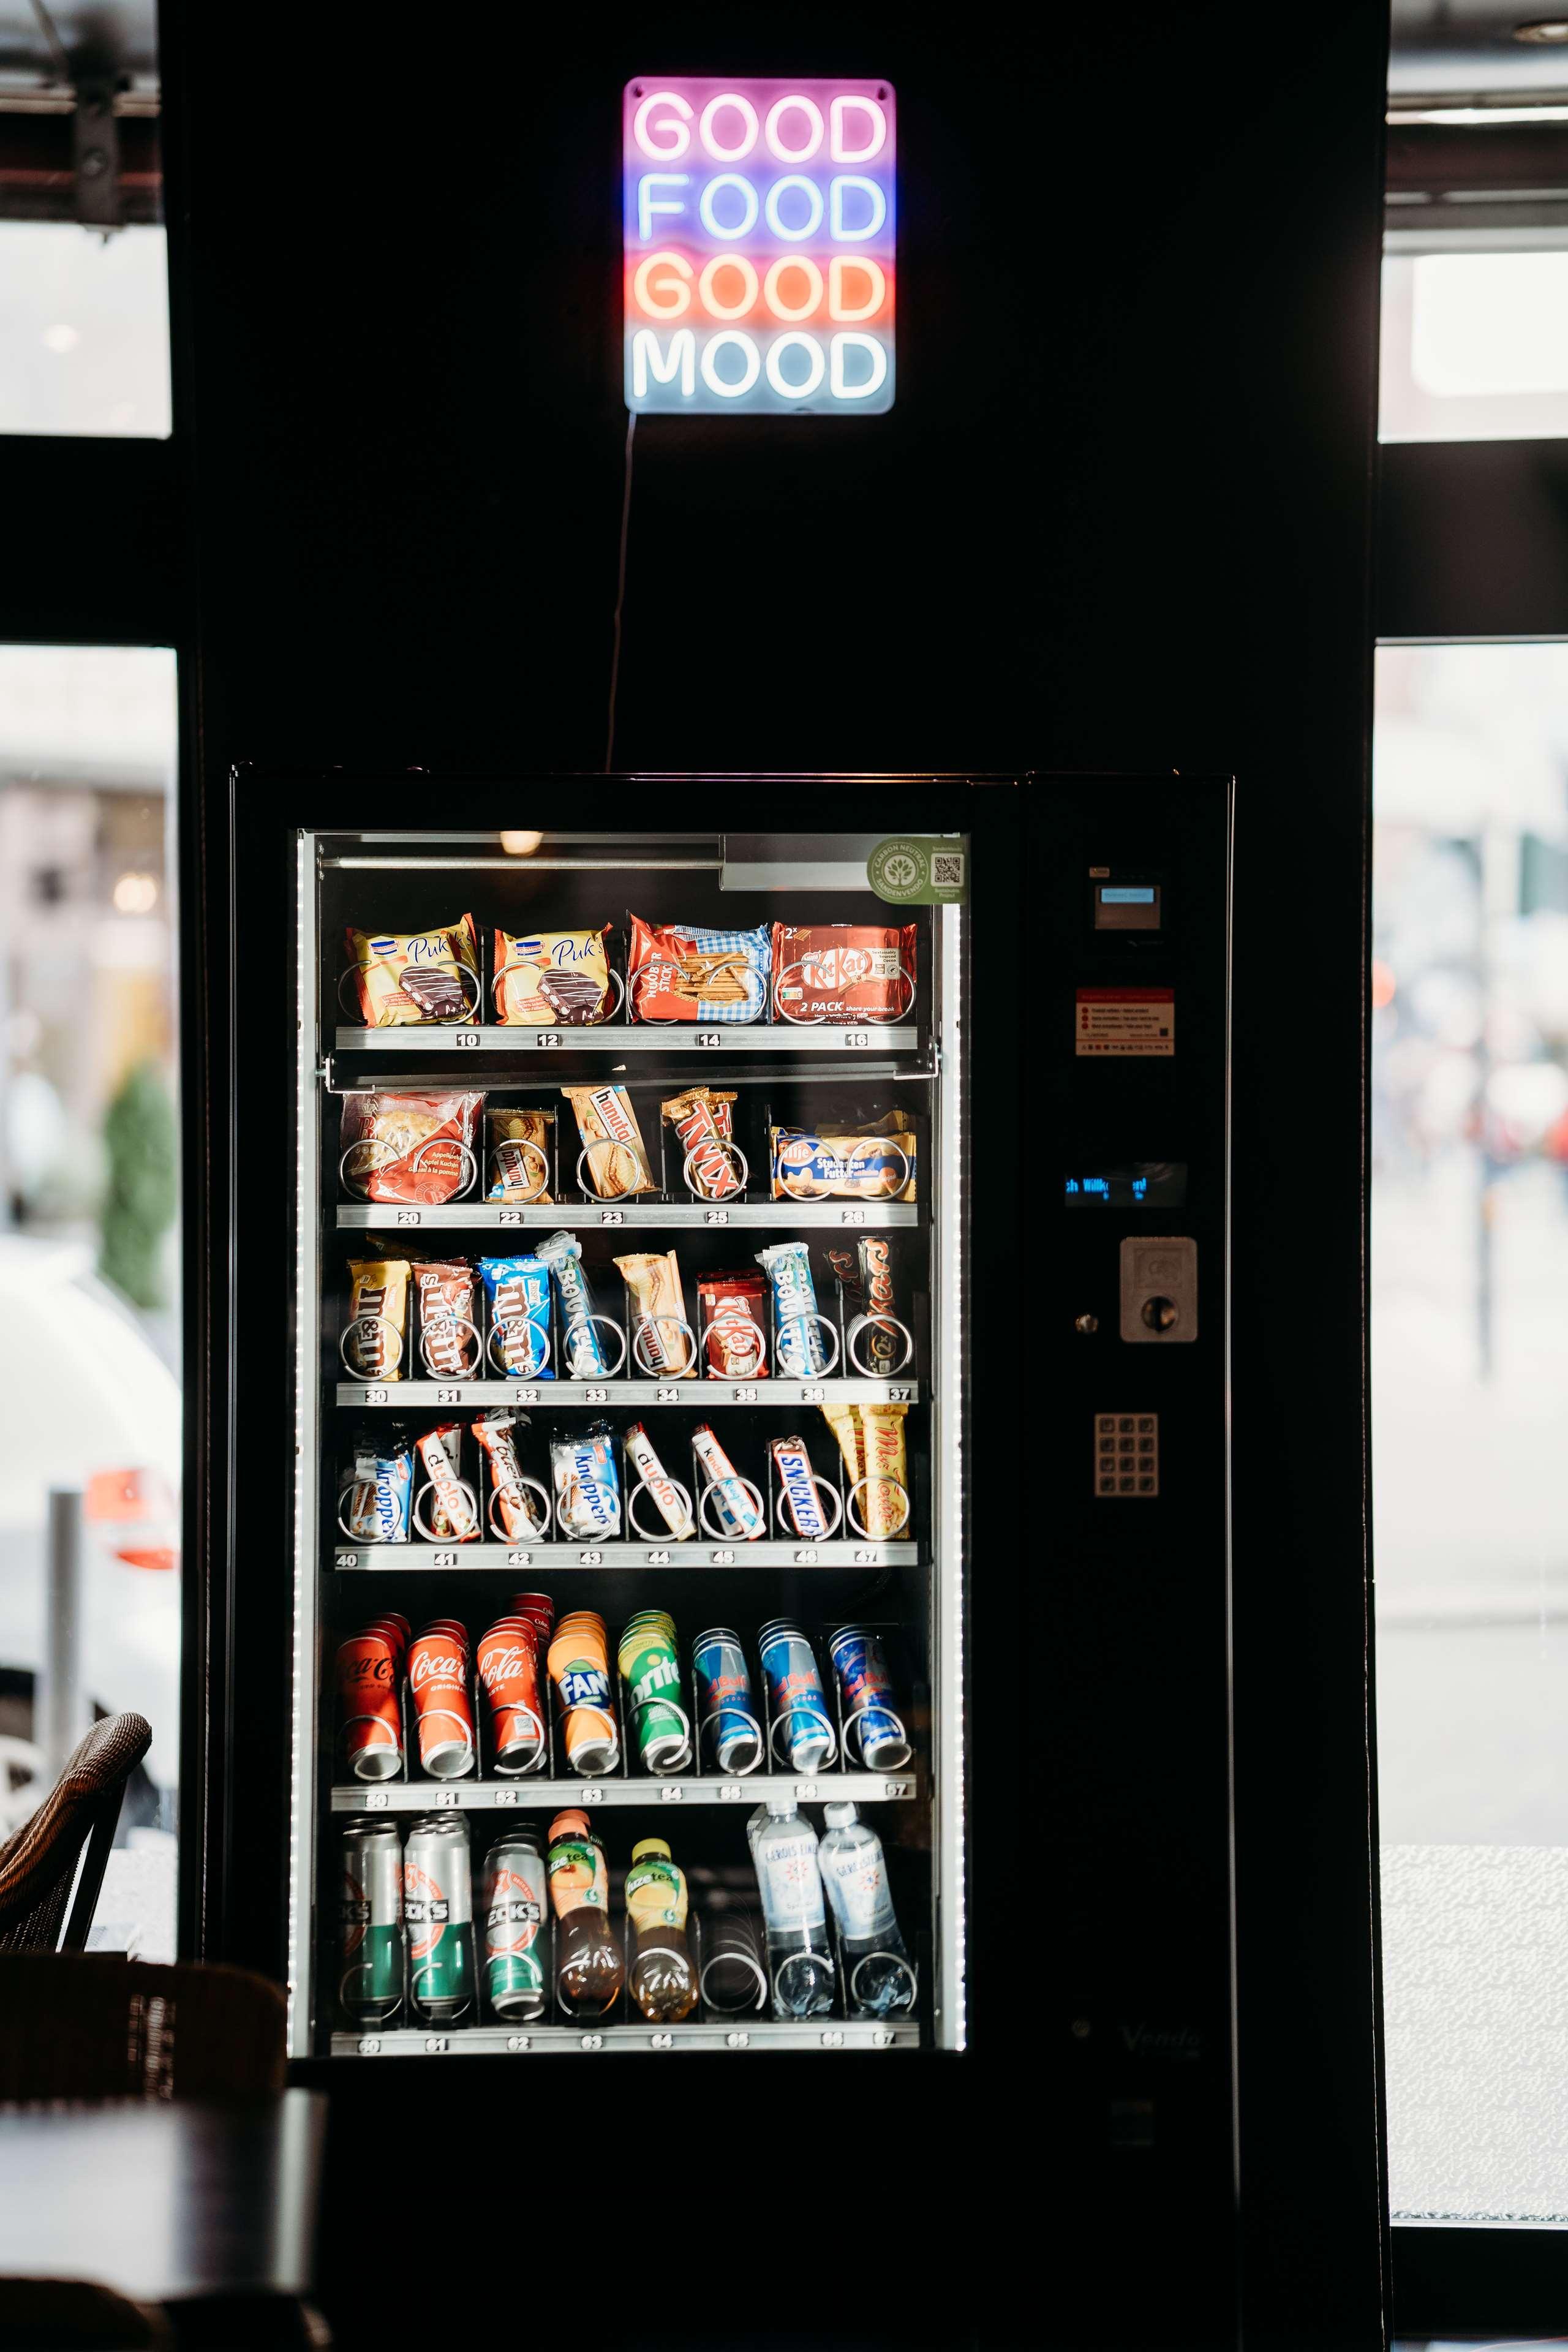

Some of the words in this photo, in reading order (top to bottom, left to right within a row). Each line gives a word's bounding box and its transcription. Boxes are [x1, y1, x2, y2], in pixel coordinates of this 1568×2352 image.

[633, 91, 887, 164] GOOD
[638, 173, 886, 241] FOOD
[633, 251, 886, 323] GOOD
[632, 328, 887, 399] MOOD
[875, 845, 899, 867] CARBON
[900, 845, 925, 868] NEUTRAL
[876, 878, 924, 897] SANDENVENDO
[552, 937, 603, 966] Puk's
[647, 952, 662, 998] HUOBR
[659, 963, 673, 992] STICK
[800, 1003, 808, 1011] 2
[811, 1001, 843, 1011] PACK
[457, 1035, 477, 1046] 10
[538, 1035, 558, 1046] 12
[700, 1035, 720, 1046] 14
[848, 1035, 867, 1046] 16
[596, 1090, 630, 1141] hanuta
[676, 1102, 739, 1199] TWIX
[784, 1146, 809, 1161] ltje
[502, 1150, 523, 1188] hanuta
[398, 1213, 419, 1224] 20
[500, 1212, 521, 1224] 22
[602, 1212, 623, 1224] 23
[707, 1212, 728, 1223] 25
[843, 1211, 864, 1223] 26
[529, 1281, 540, 1304] CRISPY
[714, 1304, 755, 1352] KtKat
[637, 1316, 665, 1368] hanua
[366, 1390, 386, 1401] 30
[439, 1390, 458, 1401] 31
[517, 1389, 538, 1401] 32
[586, 1389, 607, 1401] 33
[658, 1389, 679, 1401] 34
[736, 1389, 757, 1401] 35
[804, 1389, 824, 1400] 36
[889, 1388, 910, 1400] 37
[704, 1447, 725, 1480] Kinde
[428, 1454, 459, 1510] duplo
[638, 1453, 674, 1506] duplo
[375, 1468, 397, 1539] Knopper
[336, 1555, 357, 1567] 40
[434, 1553, 454, 1565] 41
[508, 1553, 530, 1564] 42
[580, 1553, 601, 1564] 43
[648, 1551, 669, 1563] 44
[713, 1551, 734, 1563] 45
[855, 1550, 876, 1562] 47
[480, 1645, 526, 1688] Cola
[886, 1783, 907, 1796] 57
[495, 1790, 517, 1804] 52
[582, 1789, 603, 1803] 53
[873, 2031, 896, 2045] 67
